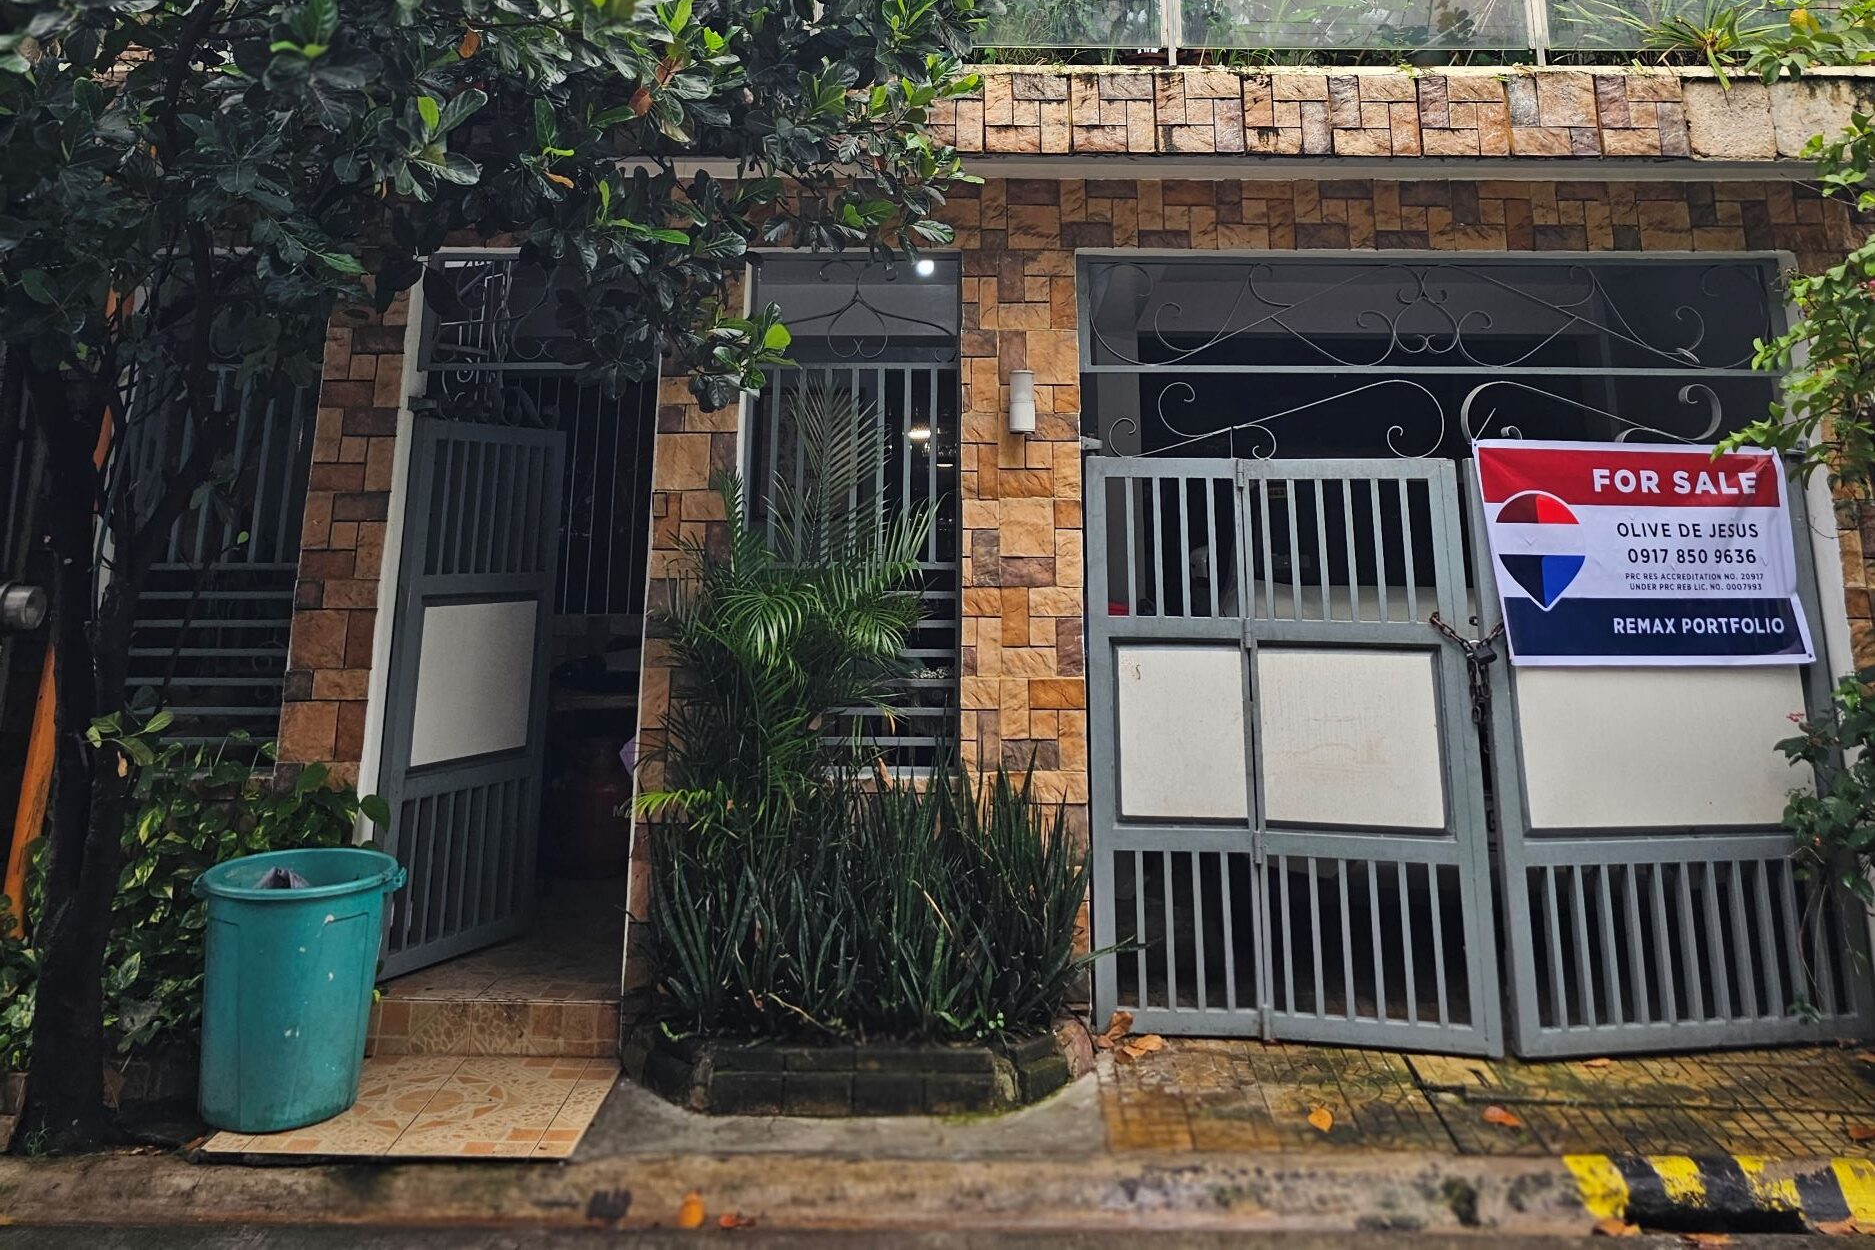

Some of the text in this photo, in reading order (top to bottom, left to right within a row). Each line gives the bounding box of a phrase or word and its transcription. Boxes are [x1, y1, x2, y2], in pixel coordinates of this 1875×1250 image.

[1592, 468, 1757, 495] FOR SALE
[1616, 522, 1759, 538] OLIVE DE JESUS
[1627, 548, 1756, 563] 0917 850 9636
[1613, 617, 1785, 634] REMAX PORTFOLIO
